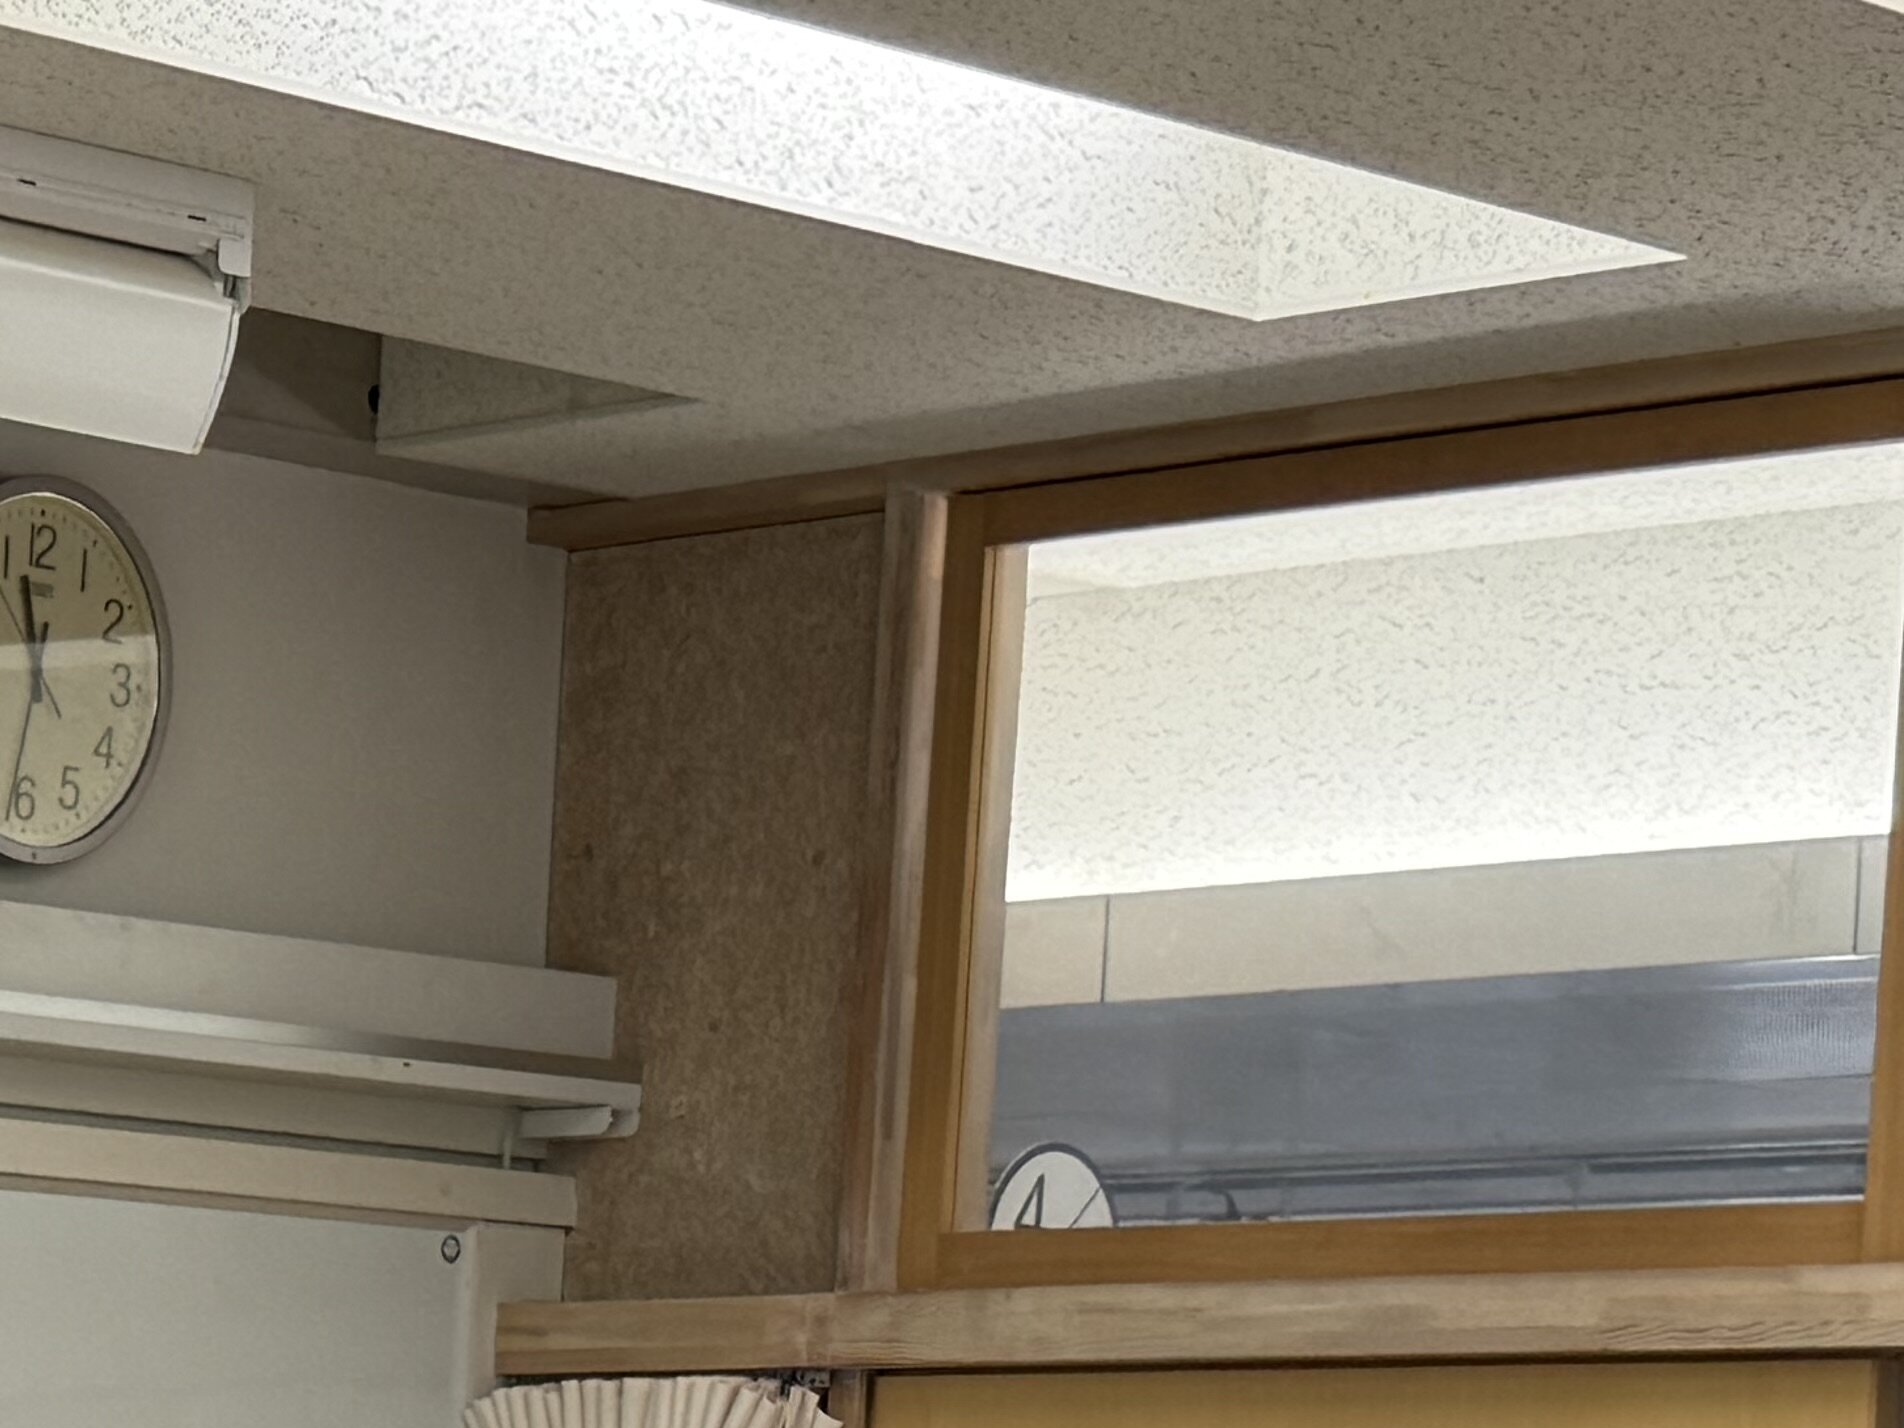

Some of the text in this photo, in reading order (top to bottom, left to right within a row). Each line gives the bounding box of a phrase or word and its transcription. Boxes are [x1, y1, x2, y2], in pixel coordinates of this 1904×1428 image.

[29, 522, 58, 571] 12
[80, 547, 88, 593] 1
[101, 597, 124, 645] 2
[109, 663, 132, 708] 3
[93, 726, 115, 769] 4
[14, 775, 36, 821] 6
[58, 765, 81, 810] 5
